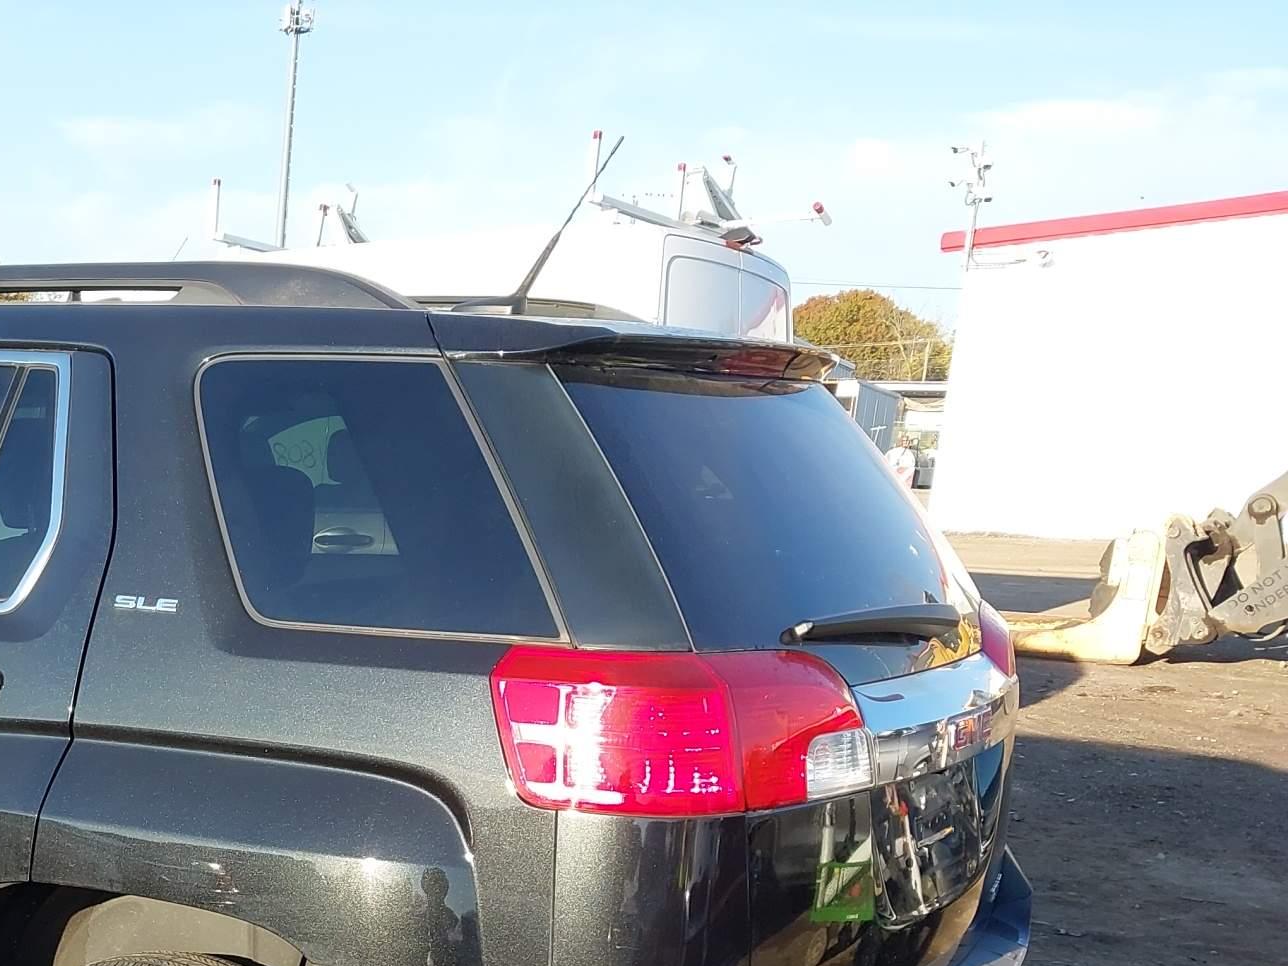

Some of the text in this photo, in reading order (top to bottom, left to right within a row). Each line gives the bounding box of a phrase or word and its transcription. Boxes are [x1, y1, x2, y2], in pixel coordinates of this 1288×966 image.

[1251, 569, 1282, 595] NOT
[113, 594, 179, 613] SLE
[948, 704, 993, 752] GMC
